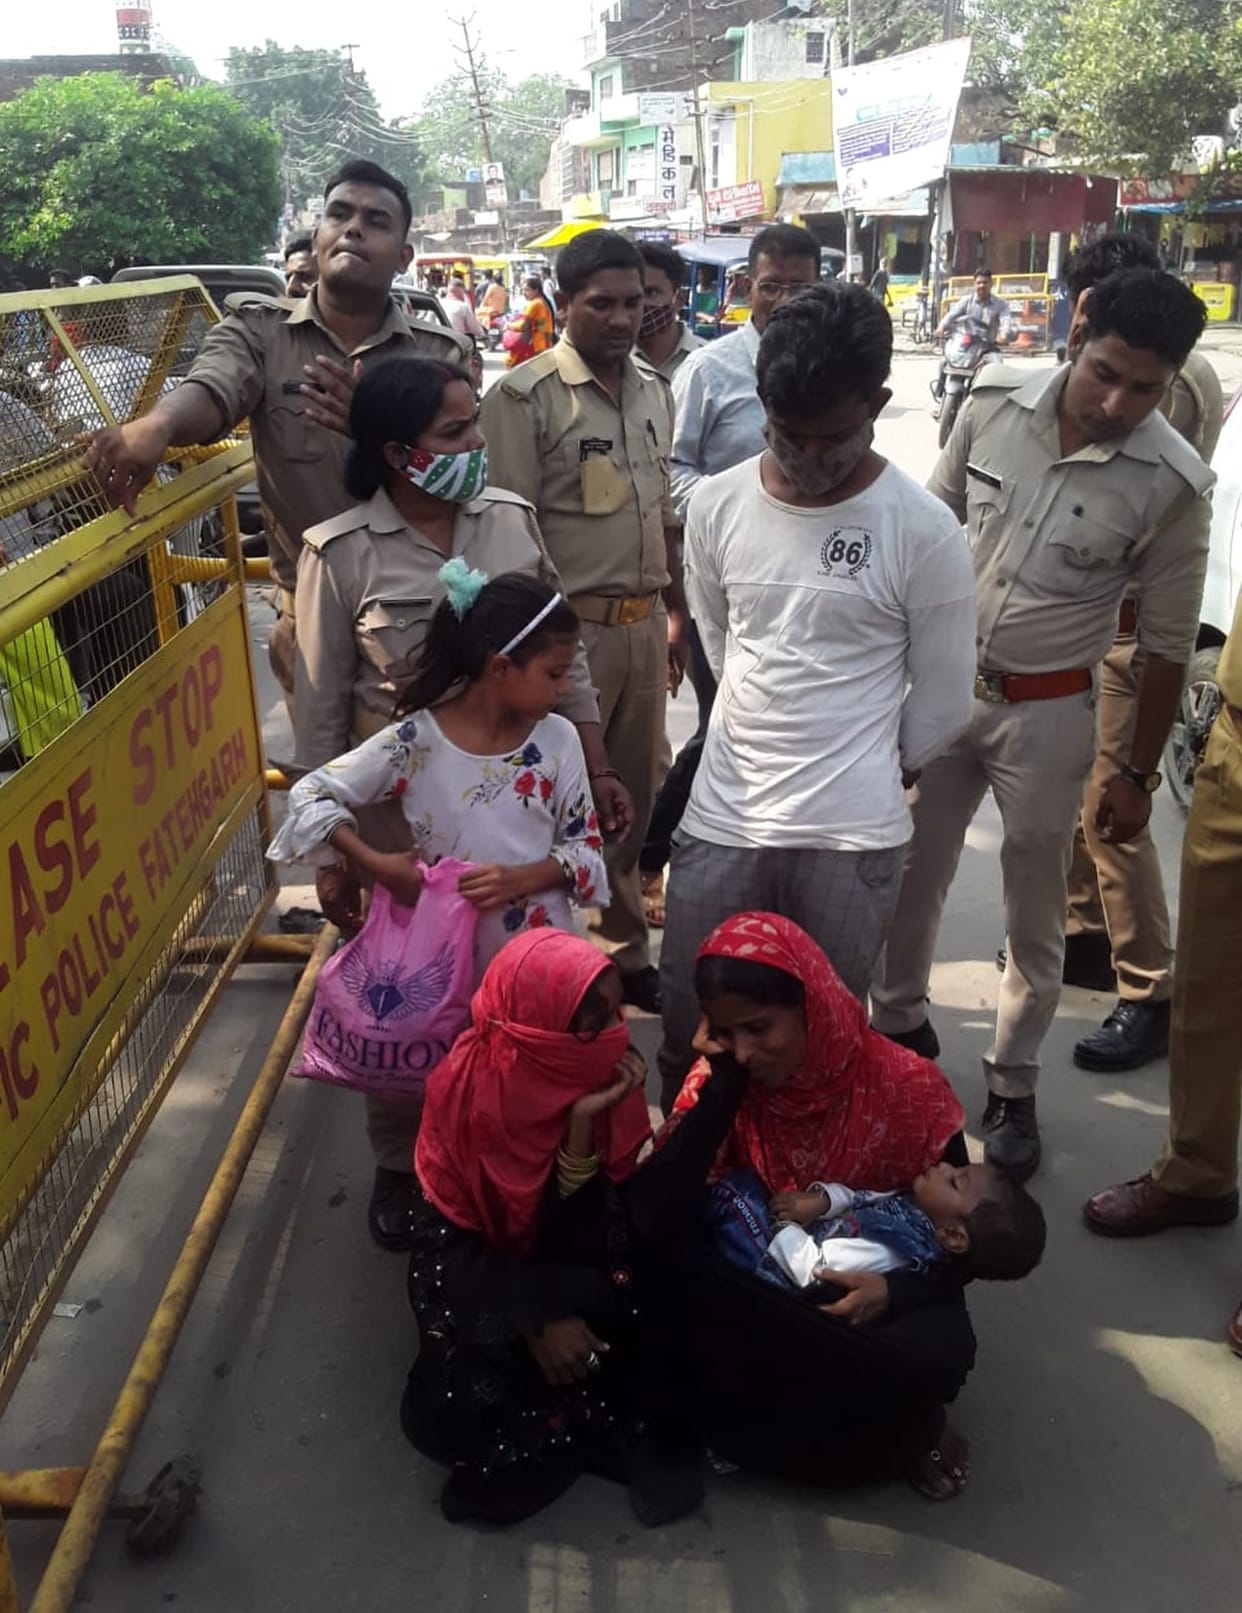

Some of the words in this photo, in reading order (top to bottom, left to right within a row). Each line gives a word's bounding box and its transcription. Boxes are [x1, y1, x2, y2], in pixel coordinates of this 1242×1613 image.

[830, 539, 863, 565] 86
[0, 766, 101, 992] ASE
[129, 644, 223, 806] STOP
[0, 1021, 39, 1122] IC
[40, 870, 140, 1053] POLICE
[138, 728, 247, 904] FATEHGARH
